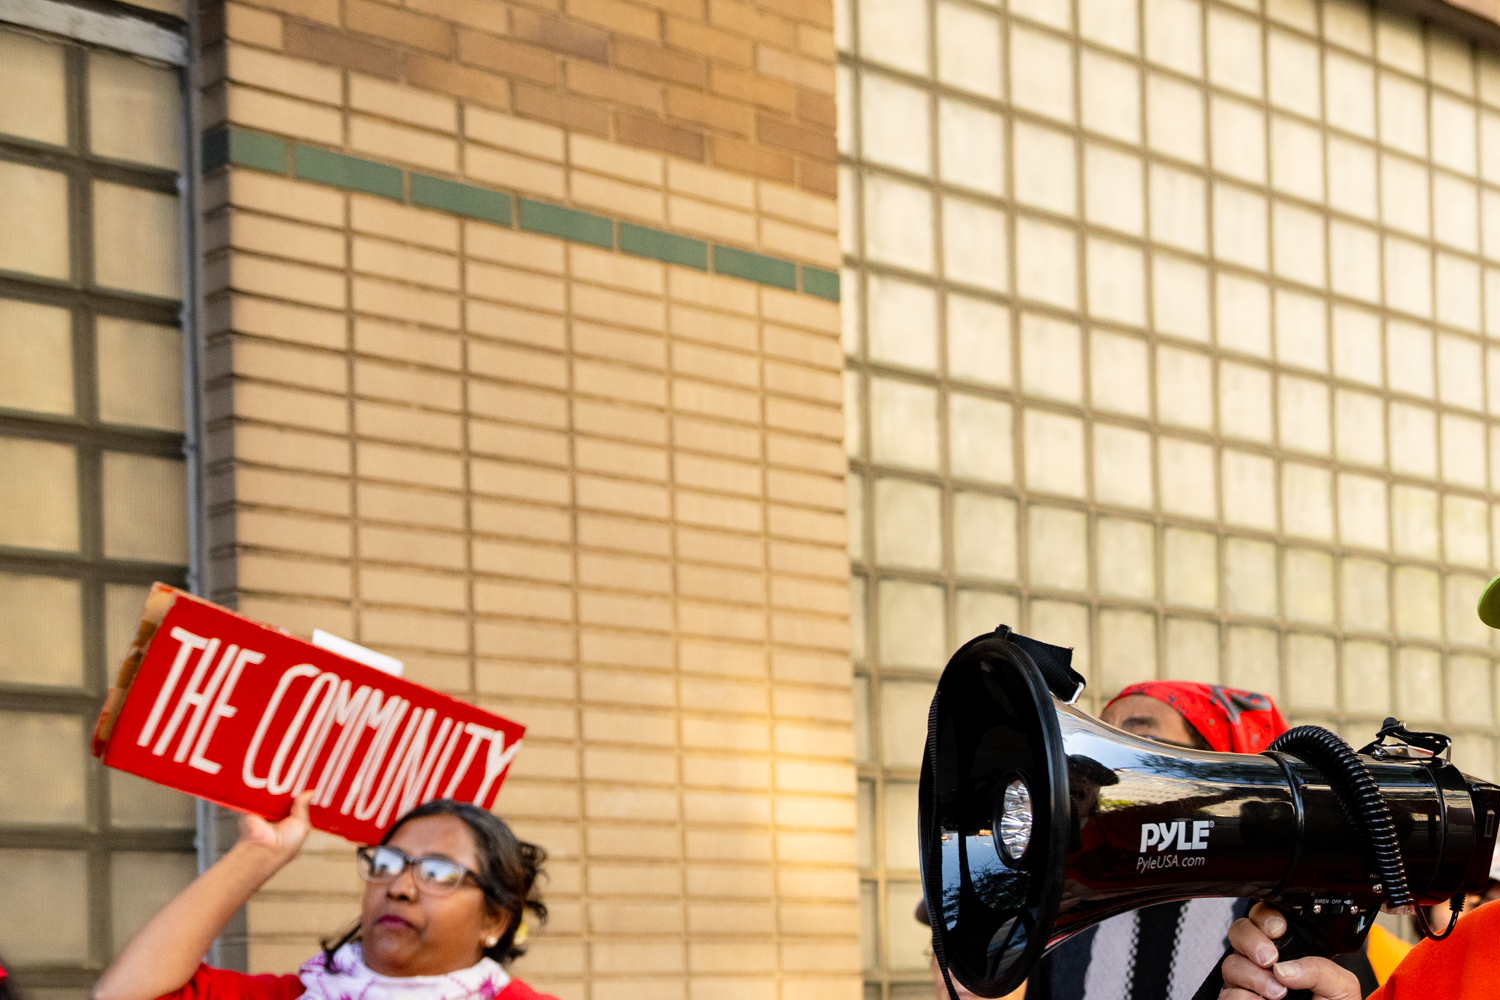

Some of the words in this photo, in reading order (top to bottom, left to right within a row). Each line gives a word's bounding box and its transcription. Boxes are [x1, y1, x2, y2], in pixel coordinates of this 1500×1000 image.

[137, 626, 266, 775] THE
[242, 663, 523, 829] COMMUNITY
[1136, 854, 1205, 874] PyleUSA.com
